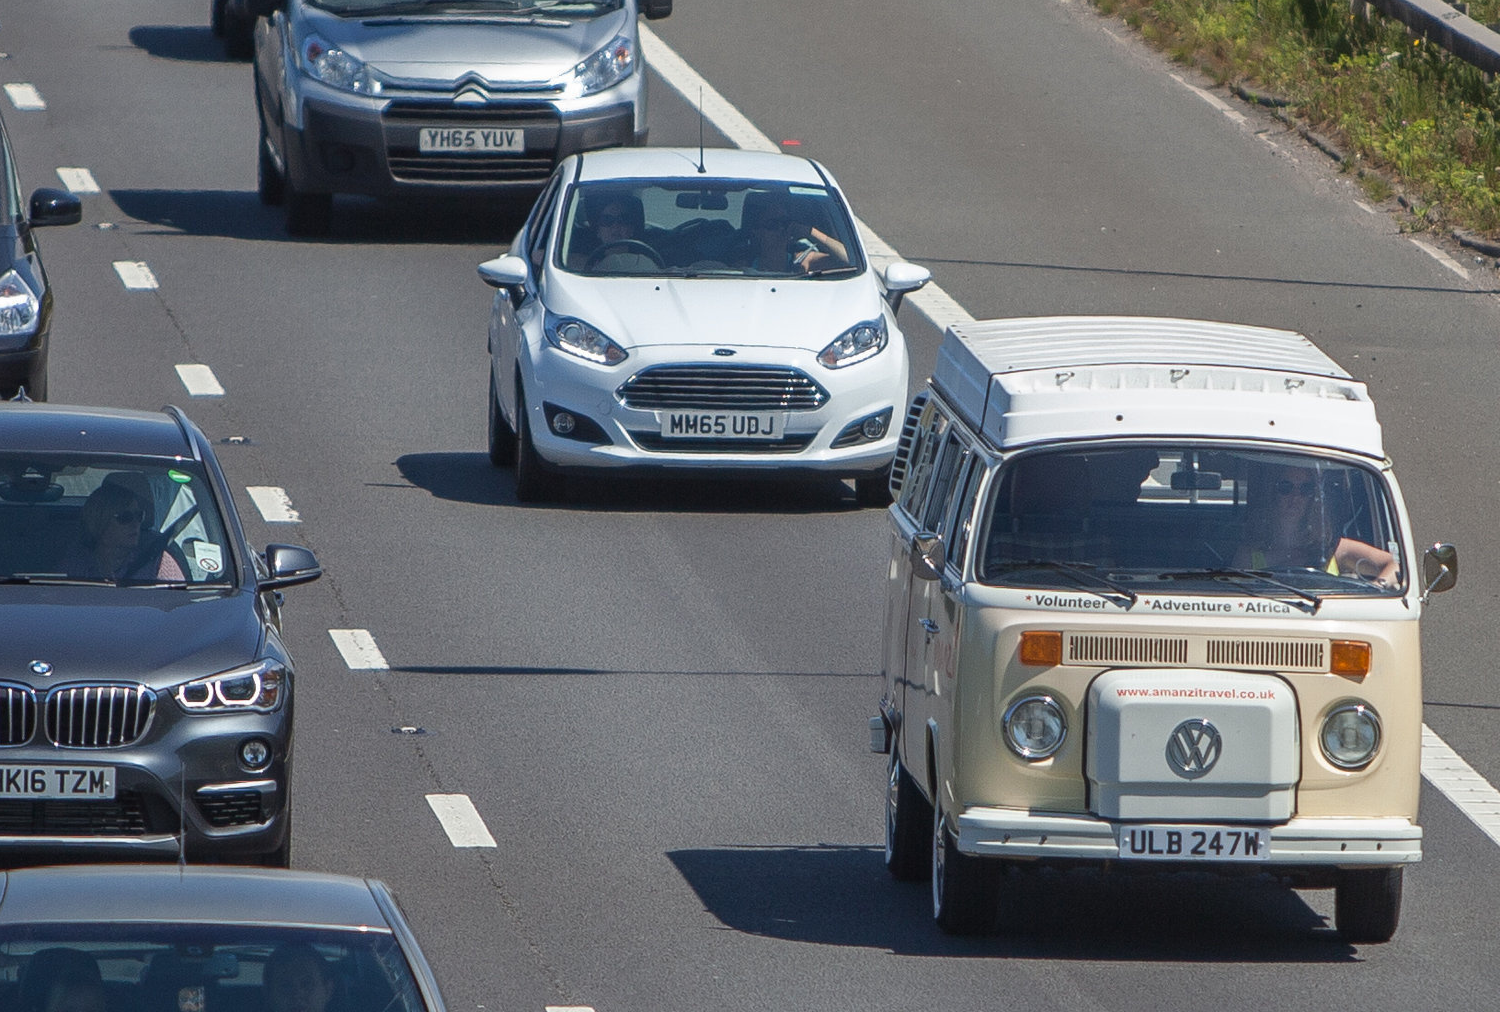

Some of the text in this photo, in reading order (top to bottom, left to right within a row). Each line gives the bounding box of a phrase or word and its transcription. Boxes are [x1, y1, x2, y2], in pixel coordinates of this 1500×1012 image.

[428, 131, 515, 147] YH65 YUV
[670, 414, 774, 435] MM65 UDJ
[1035, 594, 1291, 614] Volunteer Adventure Africa
[1116, 688, 1275, 699] www.amanzitravel.co.uk
[54, 769, 105, 794] TZM
[1130, 829, 1260, 856] ULB 247W
